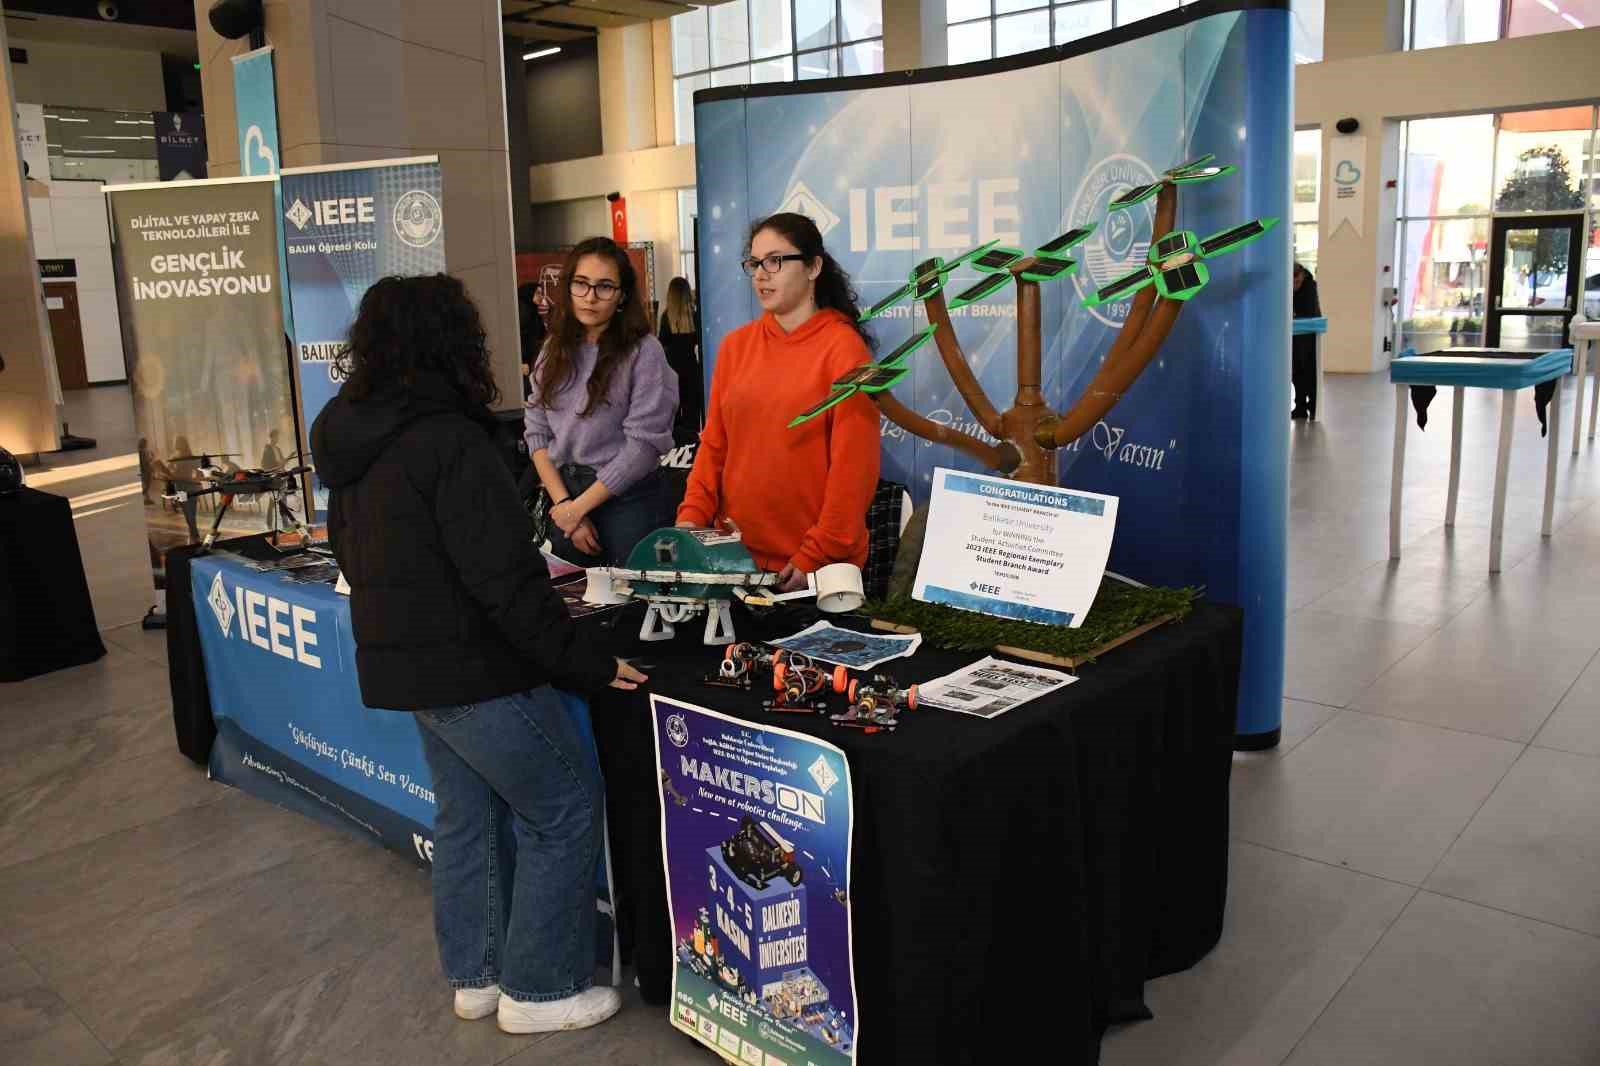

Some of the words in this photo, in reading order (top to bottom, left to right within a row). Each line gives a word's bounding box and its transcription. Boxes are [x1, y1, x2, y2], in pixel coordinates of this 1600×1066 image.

[130, 215, 173, 229] DİJİTAL
[174, 215, 190, 226] VE
[191, 213, 227, 225] YAPAY
[229, 211, 260, 223] ZEKA
[313, 196, 376, 226] IEEE
[848, 176, 1022, 253] IEEE
[141, 223, 230, 241] TEKNOLOJİLERİ
[232, 223, 251, 236] İLE
[150, 245, 246, 277] GENÇLİK
[288, 244, 316, 254] BAUN
[318, 241, 352, 254] Öğrenci
[354, 240, 377, 251] Kolu
[132, 274, 272, 301] İNOVASYONU
[979, 484, 1068, 507] CONGRATULATIONS
[971, 534, 995, 545] Student
[1016, 519, 1054, 534] University
[965, 543, 981, 552] 2023
[982, 546, 997, 555] IEEE
[998, 549, 1027, 561] Regional
[1028, 555, 1064, 569] Exemplary
[975, 554, 1002, 566] Student
[1003, 560, 1026, 571] Branch
[1027, 565, 1050, 575] Award
[978, 583, 1001, 596] IEEE
[235, 586, 322, 669] IEEE
[341, 748, 375, 777] Çünkü
[377, 764, 396, 785] Sen
[399, 773, 436, 804] Varsın
[698, 786, 714, 799] New
[714, 795, 726, 804] era
[737, 800, 766, 818] robotics
[761, 892, 801, 933] BALIKESİR
[716, 902, 751, 961] KASIM
[758, 927, 807, 970] ÜNİVERSİTESİ
[719, 999, 749, 1028] IEEE
